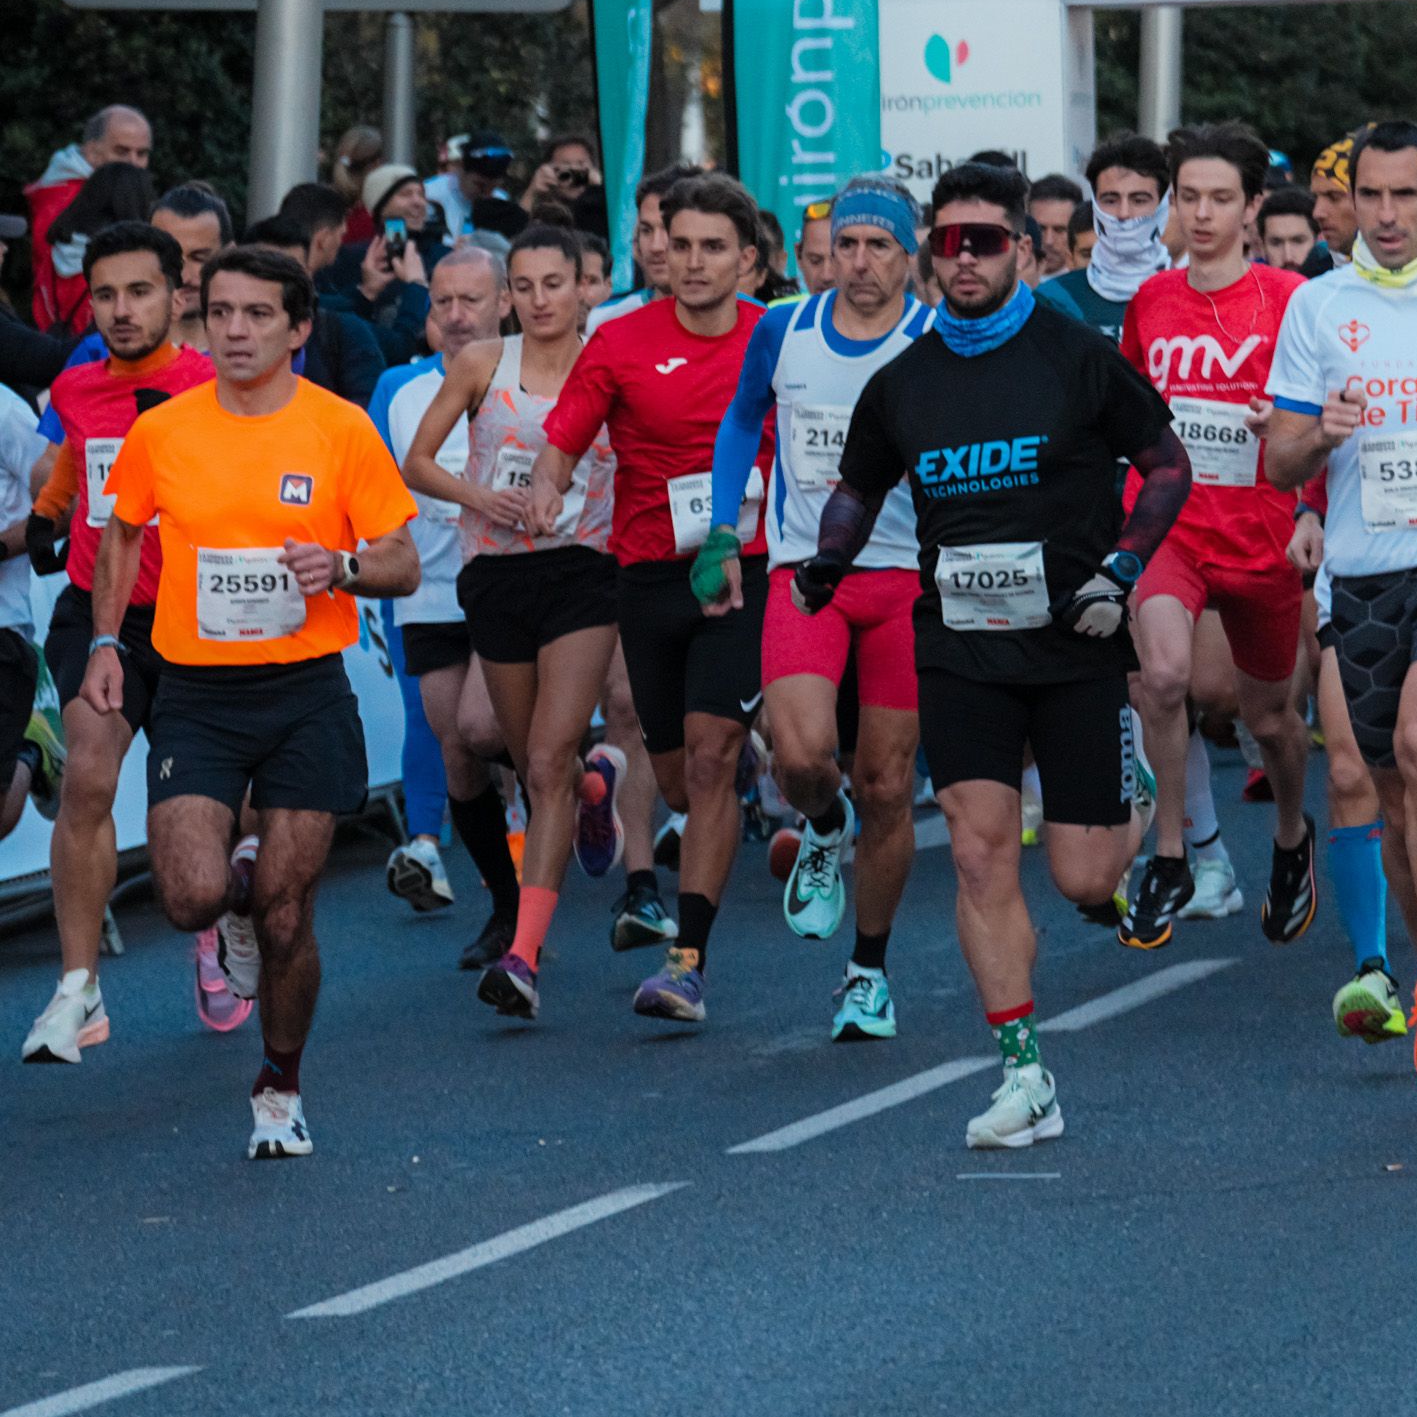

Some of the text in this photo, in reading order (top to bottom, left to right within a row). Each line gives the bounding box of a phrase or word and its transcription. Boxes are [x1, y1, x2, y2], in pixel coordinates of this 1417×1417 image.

[882, 89, 1042, 117] irónprevención
[895, 149, 1027, 180] Sabll
[1147, 334, 1263, 392] gmv
[805, 428, 846, 447] 214
[1177, 421, 1248, 445] 18668
[915, 435, 1041, 485] EXIDE
[924, 470, 1040, 499] TECHNOLOGIES
[209, 573, 290, 594] 25591
[950, 569, 1030, 590] 17025
